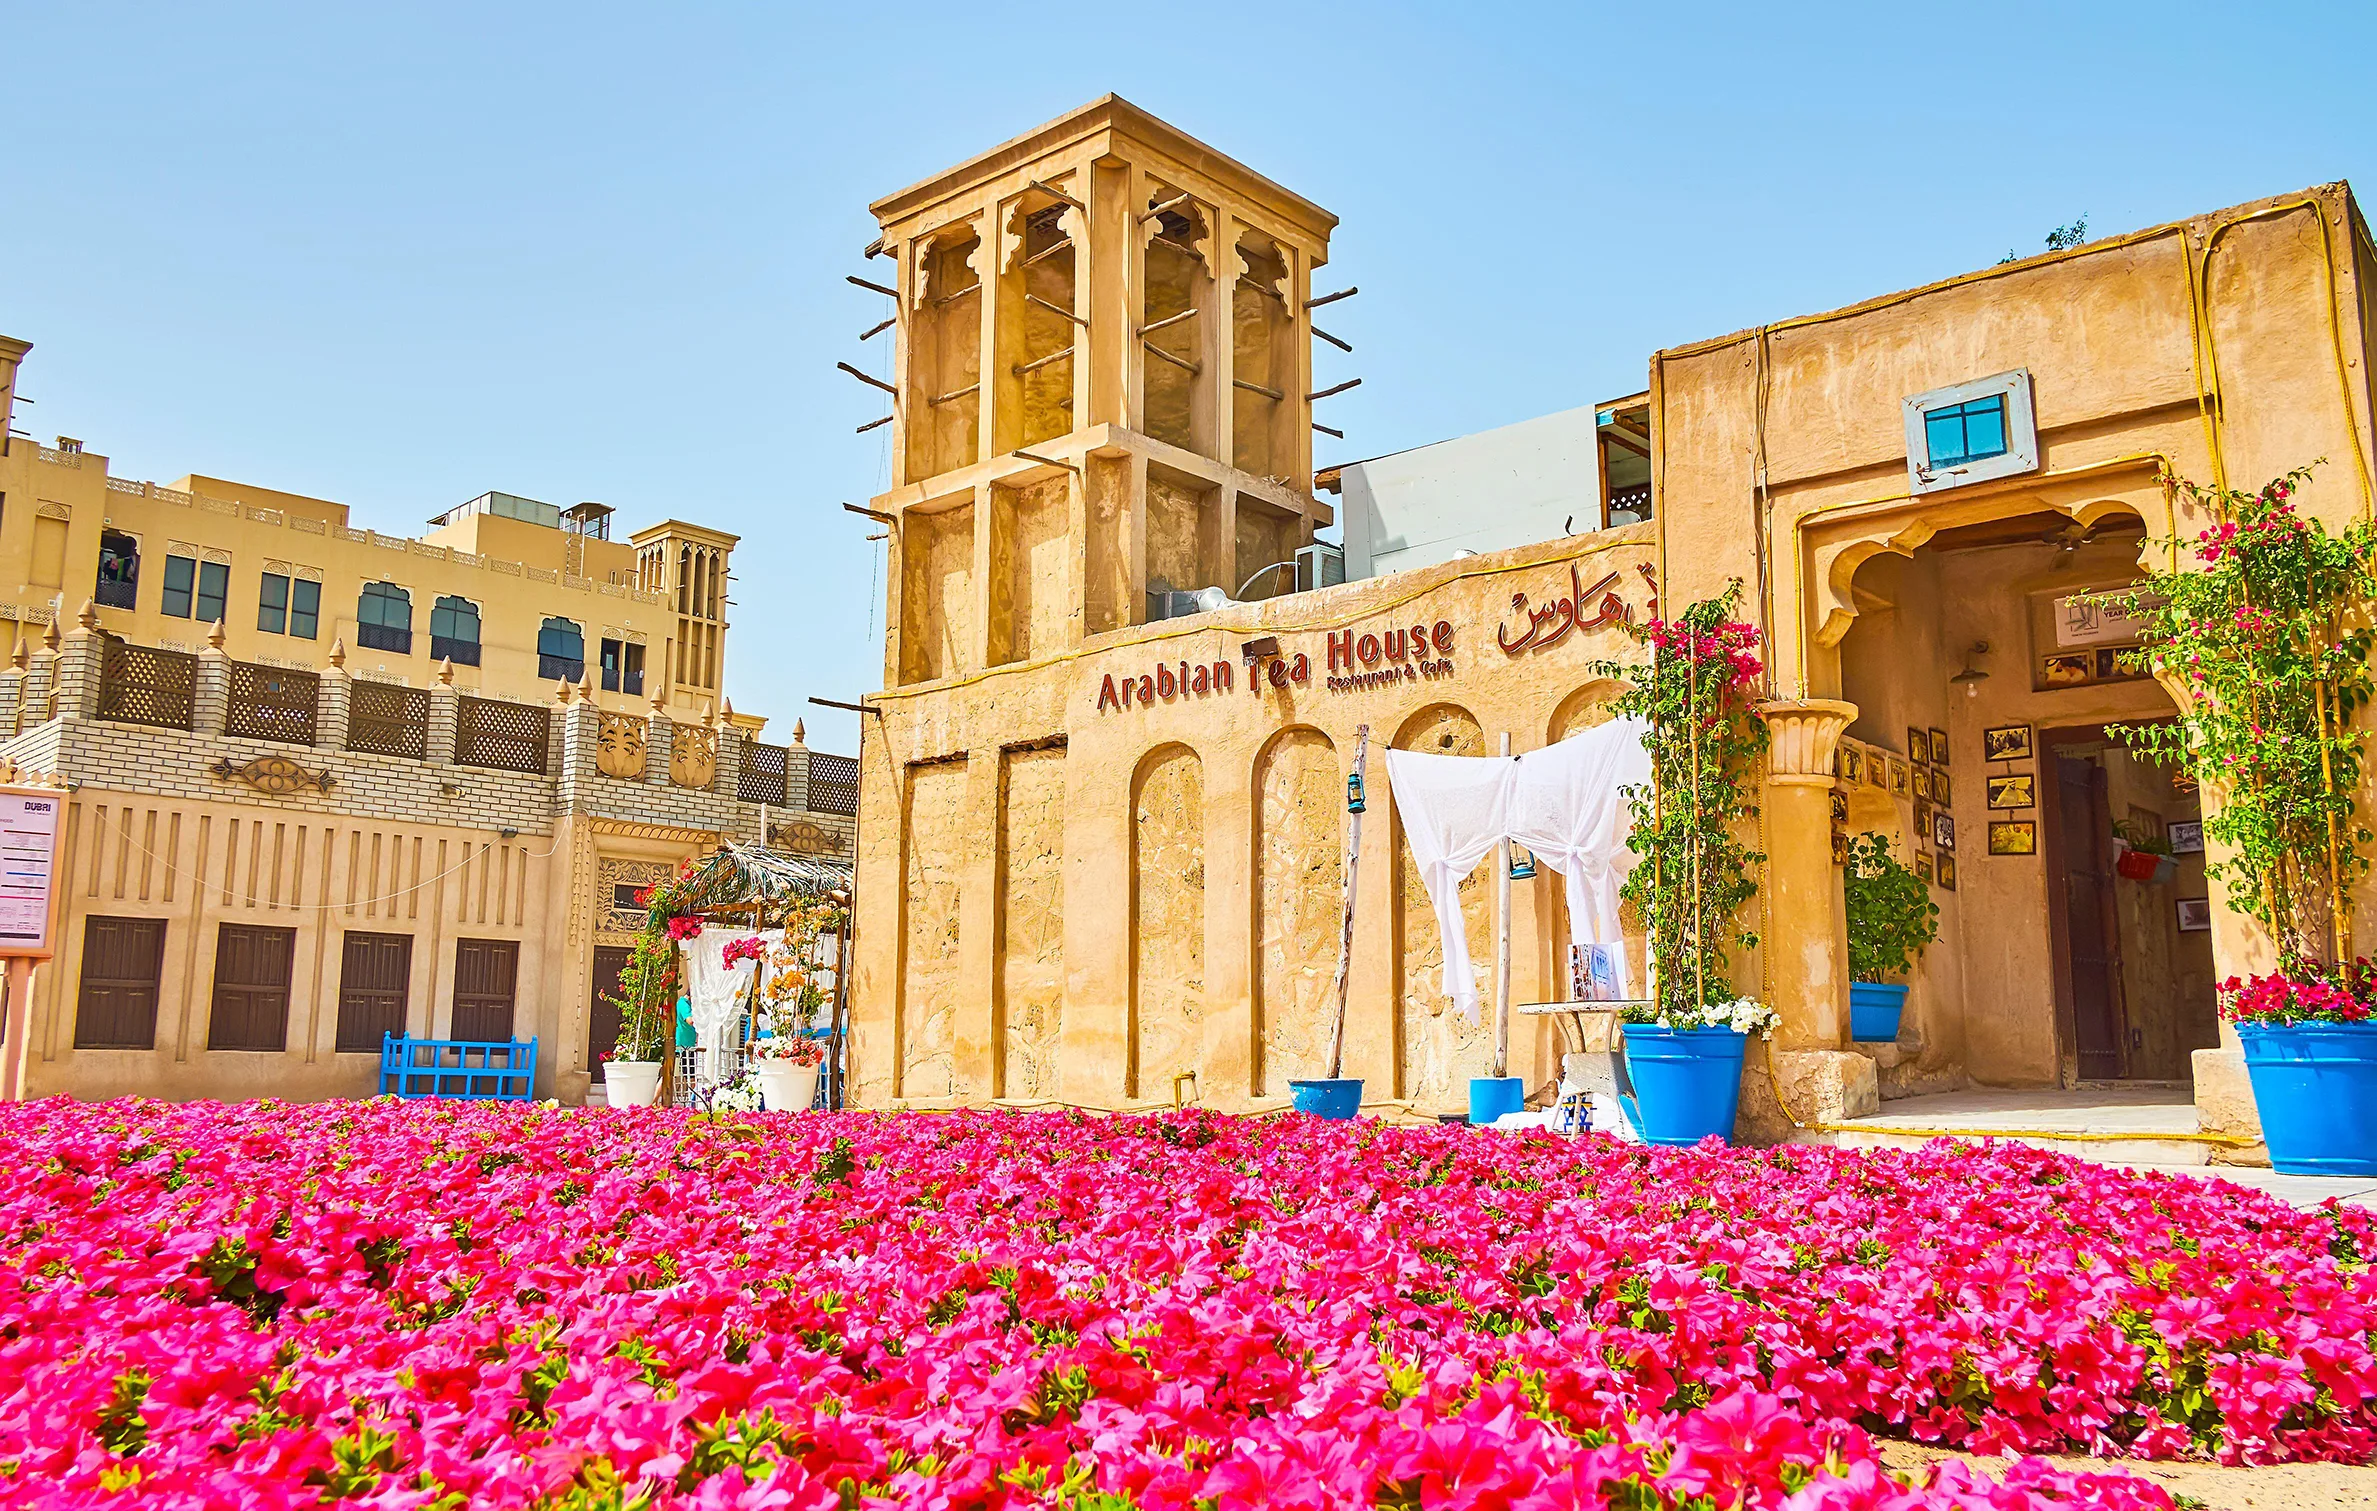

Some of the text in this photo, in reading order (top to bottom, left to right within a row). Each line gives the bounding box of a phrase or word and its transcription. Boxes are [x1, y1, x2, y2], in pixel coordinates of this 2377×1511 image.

[2104, 610, 2123, 618] YEAR
[1097, 660, 1233, 710] Arabian
[1327, 620, 1455, 671] House
[1326, 666, 1402, 690] Restaurant
[1403, 662, 1416, 677] &
[24, 801, 51, 812] DUBAI
